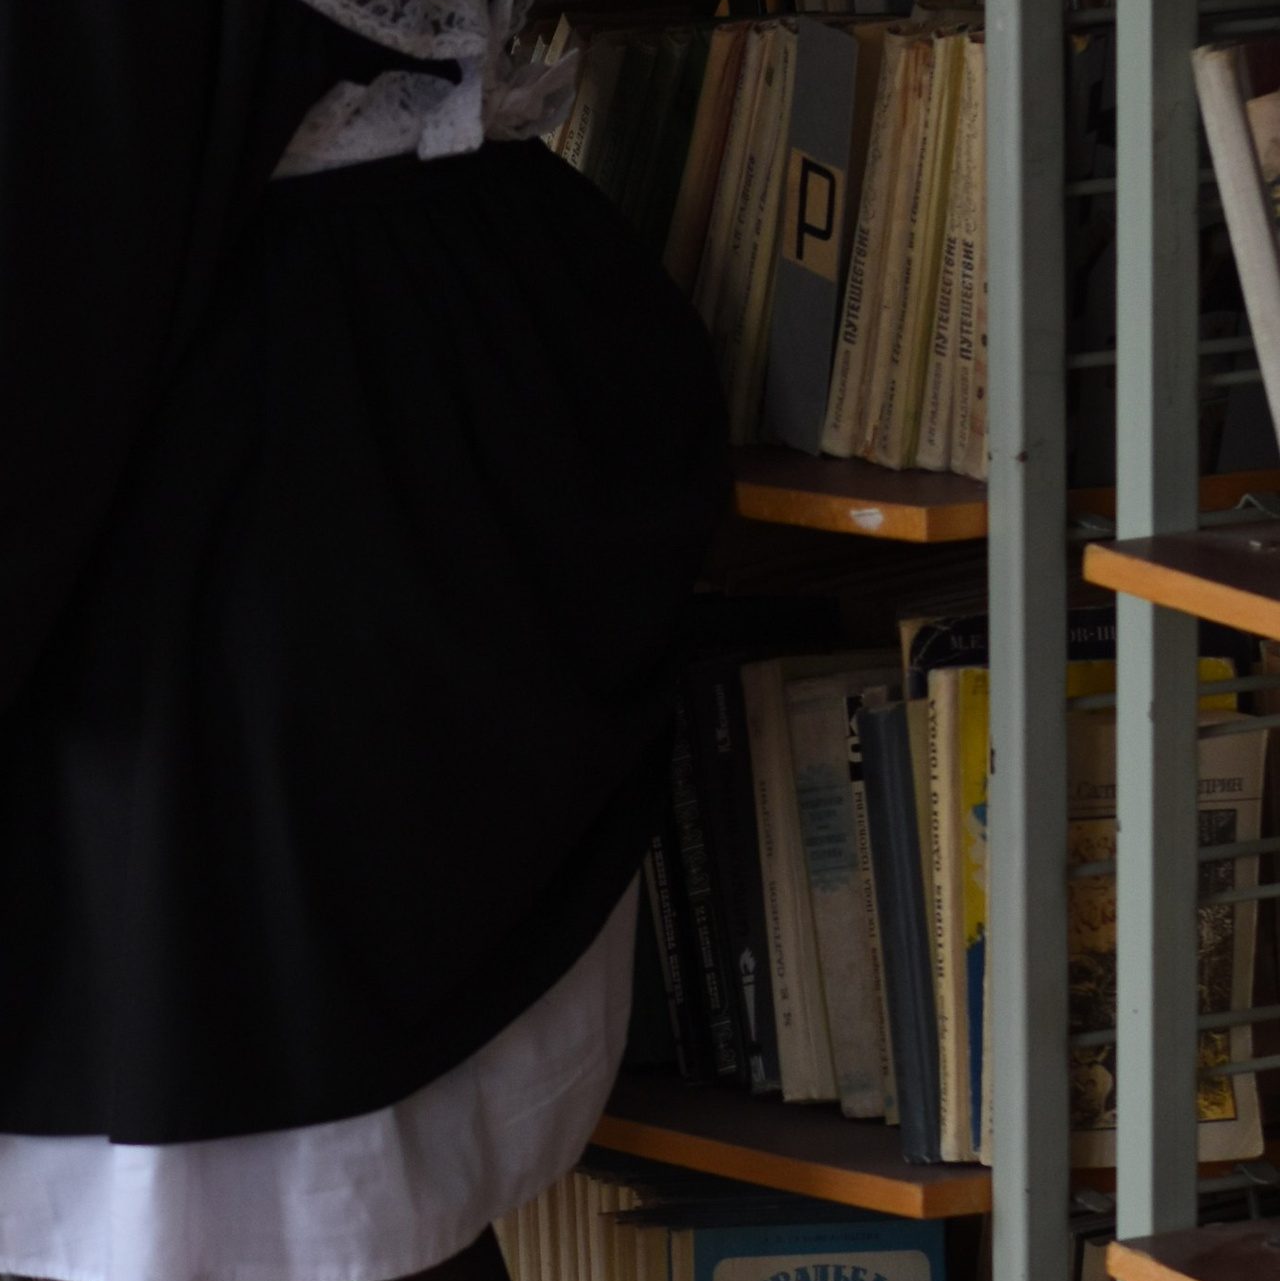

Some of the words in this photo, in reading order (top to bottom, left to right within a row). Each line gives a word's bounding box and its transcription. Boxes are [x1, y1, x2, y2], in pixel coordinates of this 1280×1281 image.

[841, 225, 870, 344] ПУТЕШЕСТВИЕ
[933, 234, 956, 357] ПУТЕШЕСТВИЕ
[958, 239, 974, 360] ПУТЕШЕСТВИЕ
